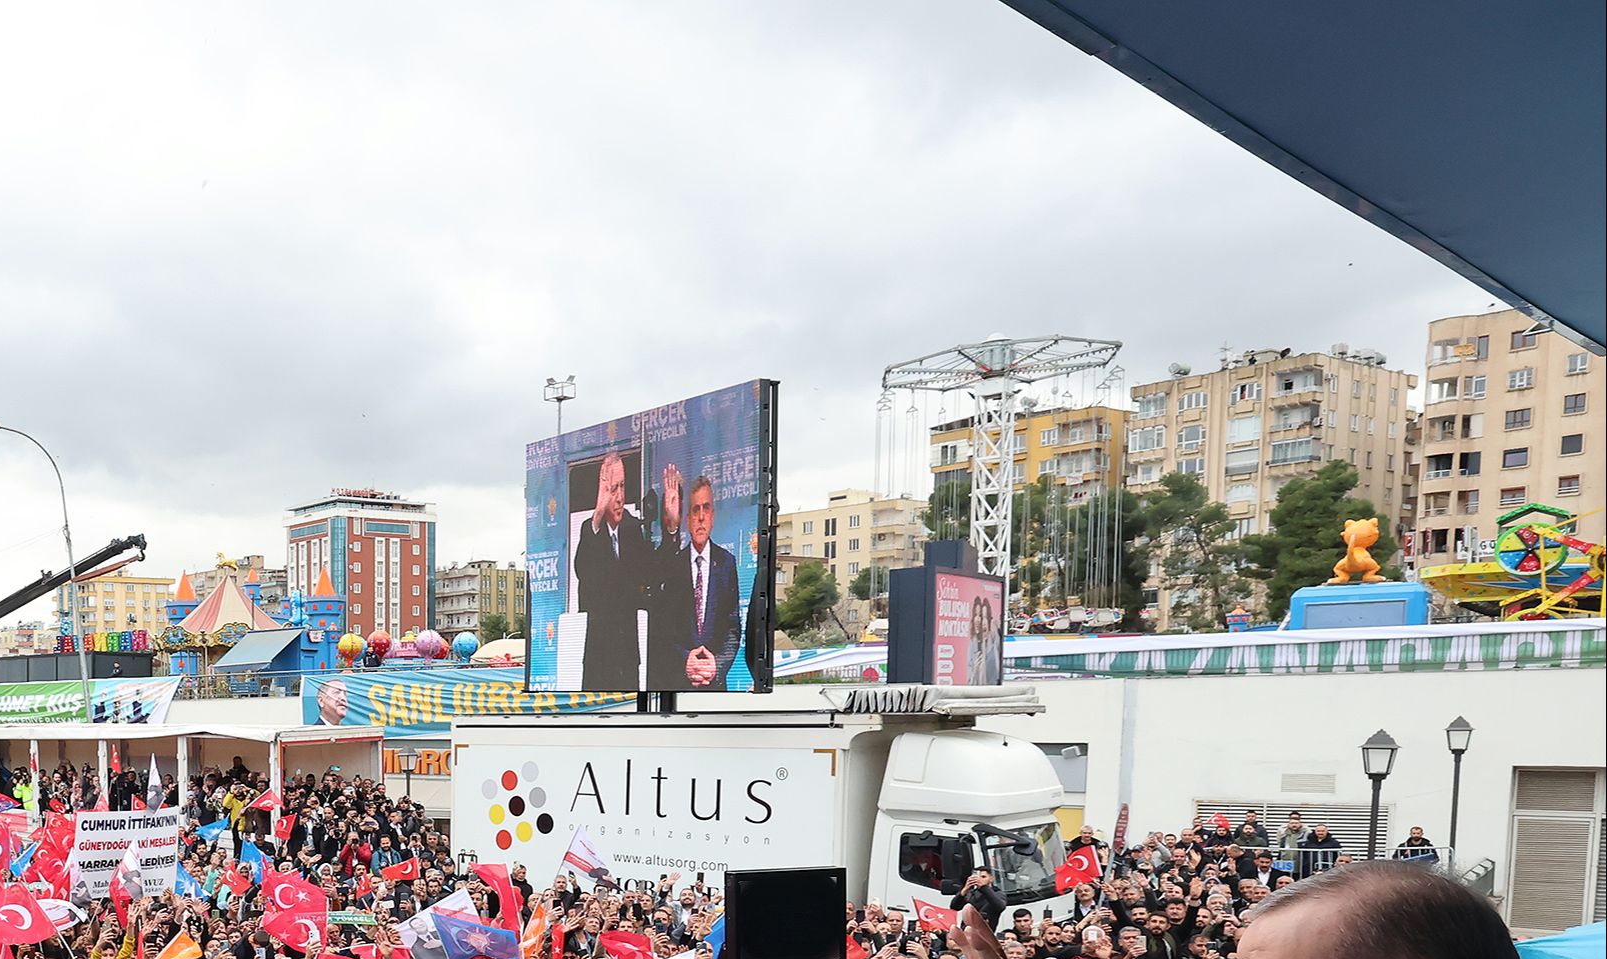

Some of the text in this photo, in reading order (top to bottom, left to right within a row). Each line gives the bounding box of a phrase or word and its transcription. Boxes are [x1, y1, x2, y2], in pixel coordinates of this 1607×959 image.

[570, 759, 772, 824] Altus
[81, 819, 126, 831] CUMHUR
[140, 853, 176, 867] LEDİYESİ
[613, 853, 729, 872] www.altusorg.com
